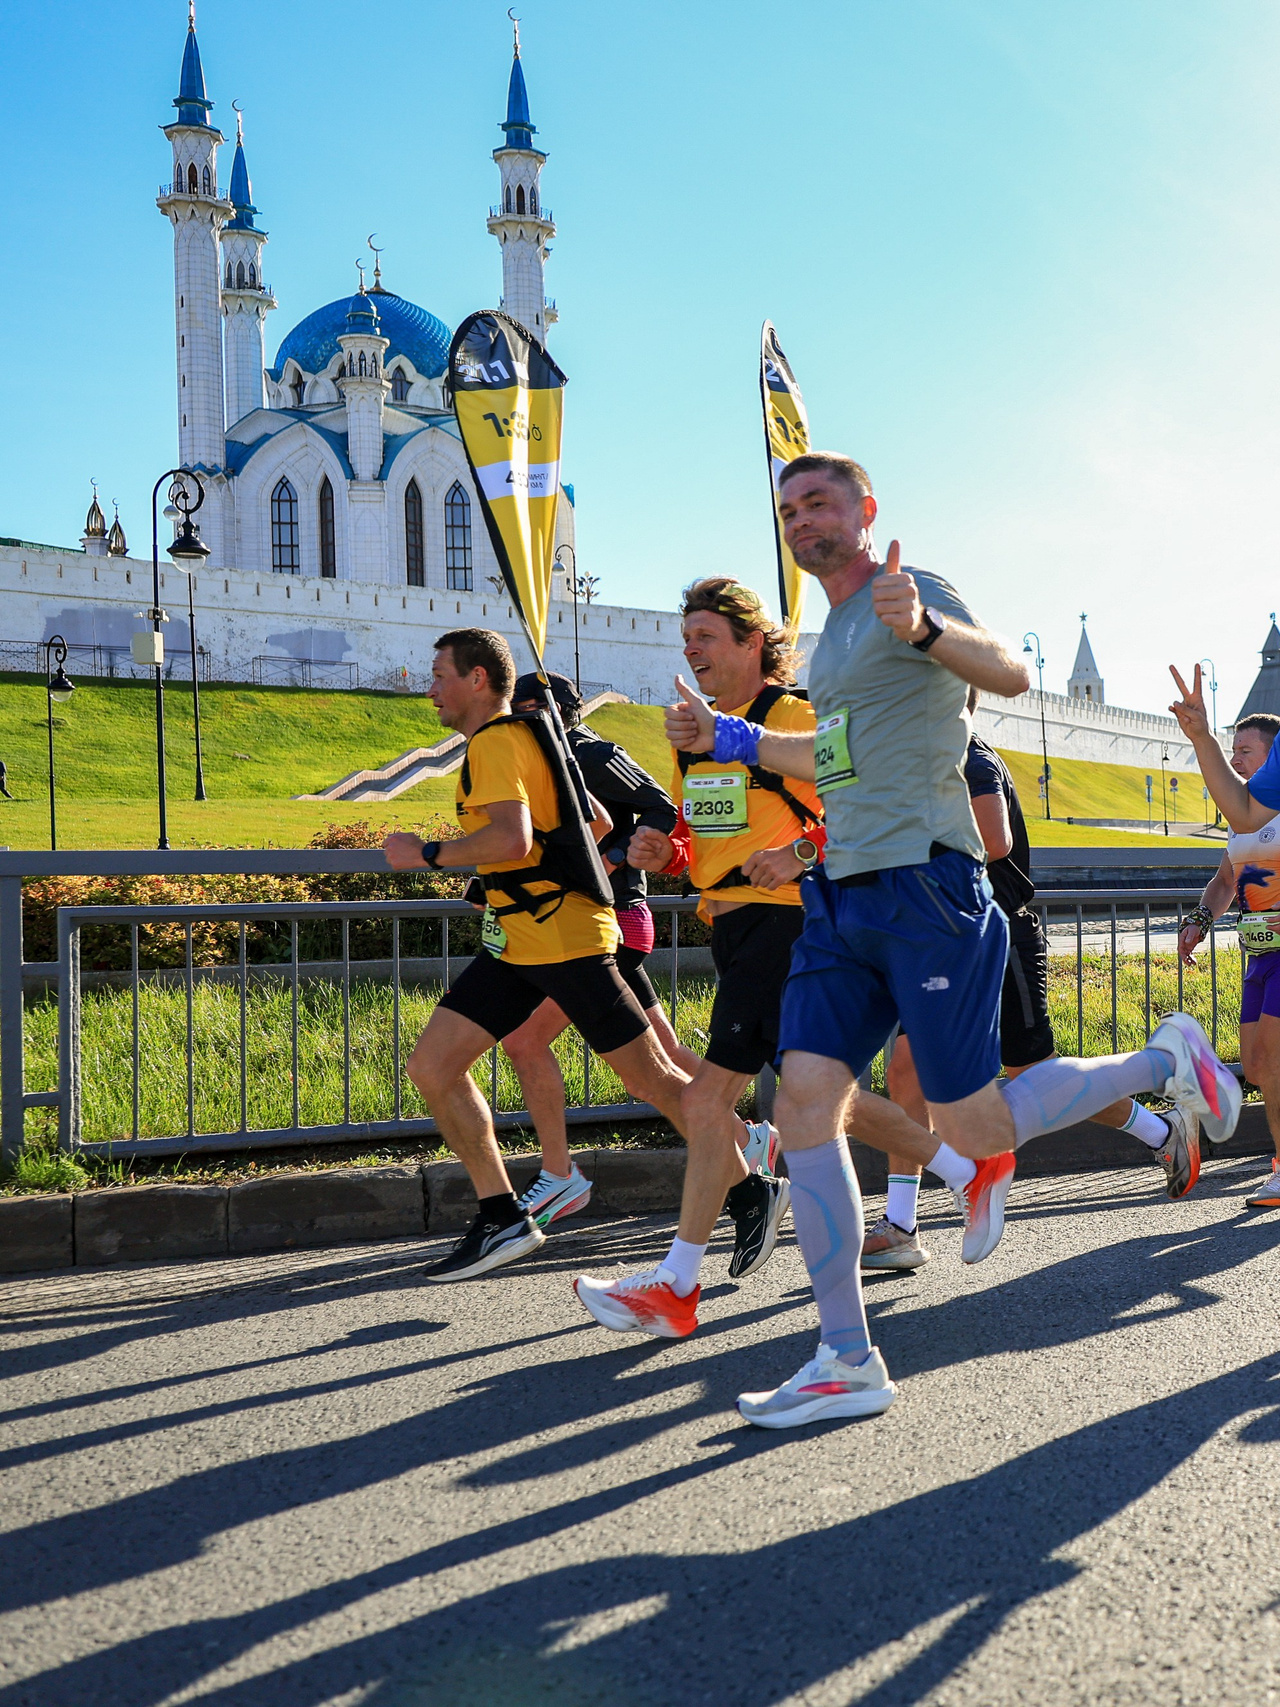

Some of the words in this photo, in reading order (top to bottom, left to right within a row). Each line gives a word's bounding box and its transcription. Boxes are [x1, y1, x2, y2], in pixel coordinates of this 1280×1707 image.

[685, 803, 691, 815] B
[693, 800, 734, 816] 2303
[1246, 931, 1274, 942] 1468
